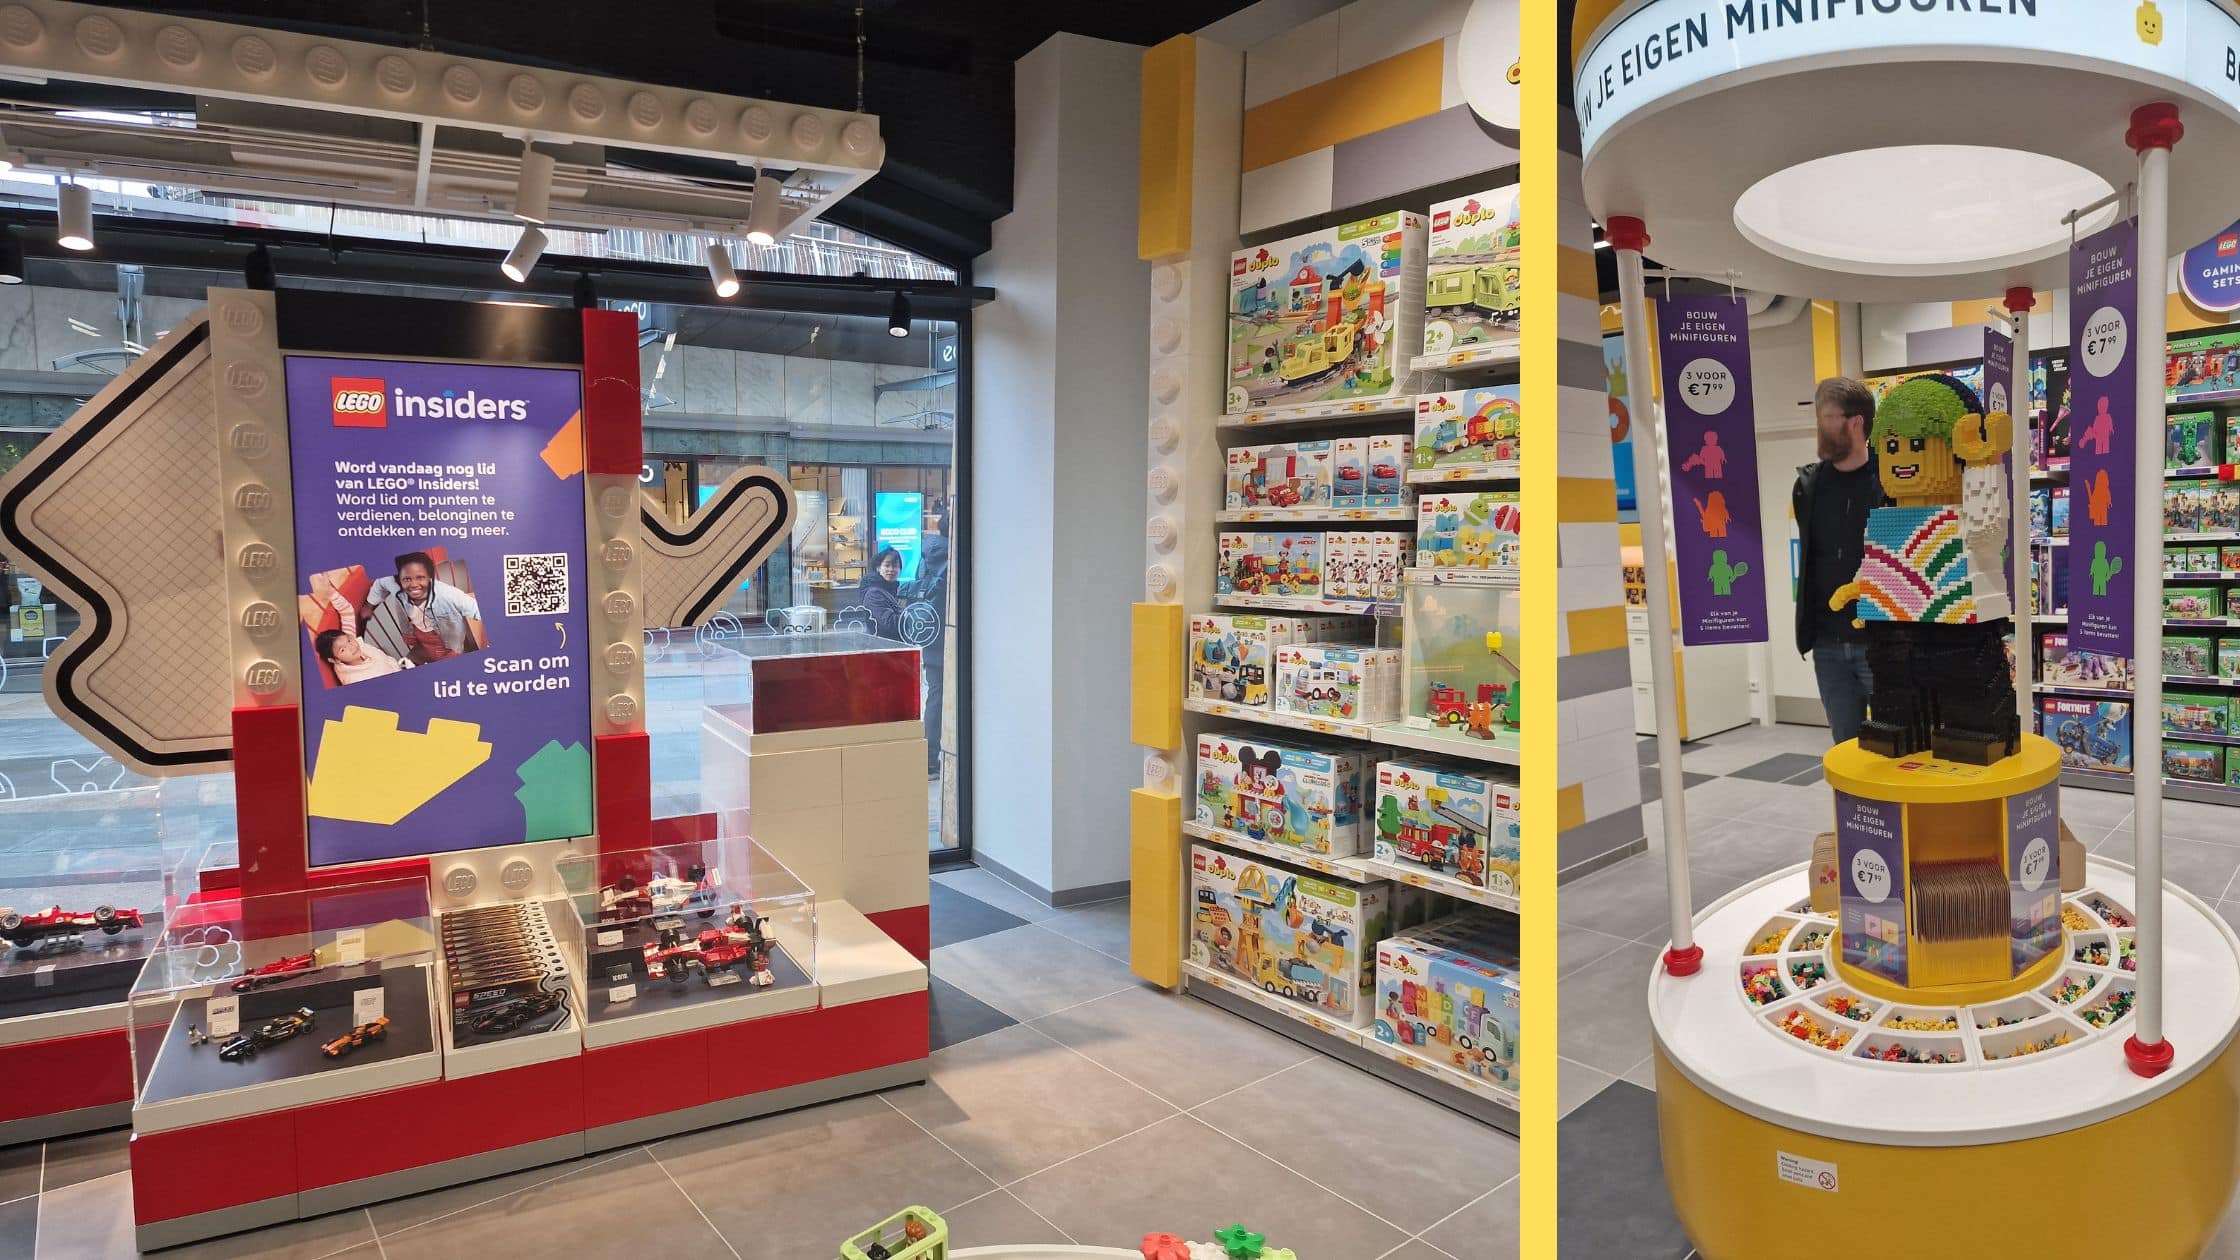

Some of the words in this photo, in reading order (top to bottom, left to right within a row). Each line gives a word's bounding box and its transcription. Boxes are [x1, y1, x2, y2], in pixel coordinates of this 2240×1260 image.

[1597, 64, 1615, 109] JE
[1621, 12, 1709, 86] EIGEN
[1453, 208, 1496, 228] duplo
[2218, 239, 2237, 252] LEGO
[2090, 246, 2118, 264] BOUW
[2085, 268, 2096, 279] JE
[2097, 258, 2123, 274] EIGEN
[2203, 263, 2240, 278] GAMIN
[1686, 311, 1718, 320] BOUW
[1680, 322, 1692, 331] JE
[1695, 322, 1726, 331] EIGEN
[2087, 328, 2092, 338] 3
[2094, 320, 2121, 335] VOOR
[1425, 329, 1443, 345] 2+
[1686, 372, 1692, 380] 3
[1695, 371, 1727, 380] VOOR
[334, 390, 384, 412] LEGO
[335, 461, 376, 474] Word
[380, 461, 442, 477] vandaag
[447, 464, 474, 477] nog
[478, 462, 496, 475] lid
[336, 479, 364, 489] van
[418, 478, 480, 490] Insiders!
[337, 493, 376, 505] Word
[380, 494, 398, 506] lid
[402, 496, 425, 506] om
[429, 495, 478, 508] punten
[482, 494, 496, 506] te
[338, 509, 415, 522] verdienen,
[418, 509, 498, 524] belonginen
[501, 508, 515, 520] te
[338, 525, 415, 537] ontdekken
[419, 527, 437, 537] en
[441, 527, 468, 539] nog
[471, 527, 510, 537] meer.
[242, 552, 273, 568] LEGO
[245, 613, 277, 628] LEGO
[484, 657, 533, 674] Scan
[538, 655, 570, 670] om
[248, 670, 280, 686] LEGO
[434, 679, 461, 698] lid
[467, 680, 488, 696] te
[493, 674, 570, 694] worden
[2056, 702, 2091, 714] FORTNITE
[1856, 804, 1879, 815] BOUW
[1853, 813, 1861, 821] JE
[1863, 815, 1885, 827] EIGEN
[1863, 860, 1885, 873] VOOR
[473, 988, 506, 999] SPEED
